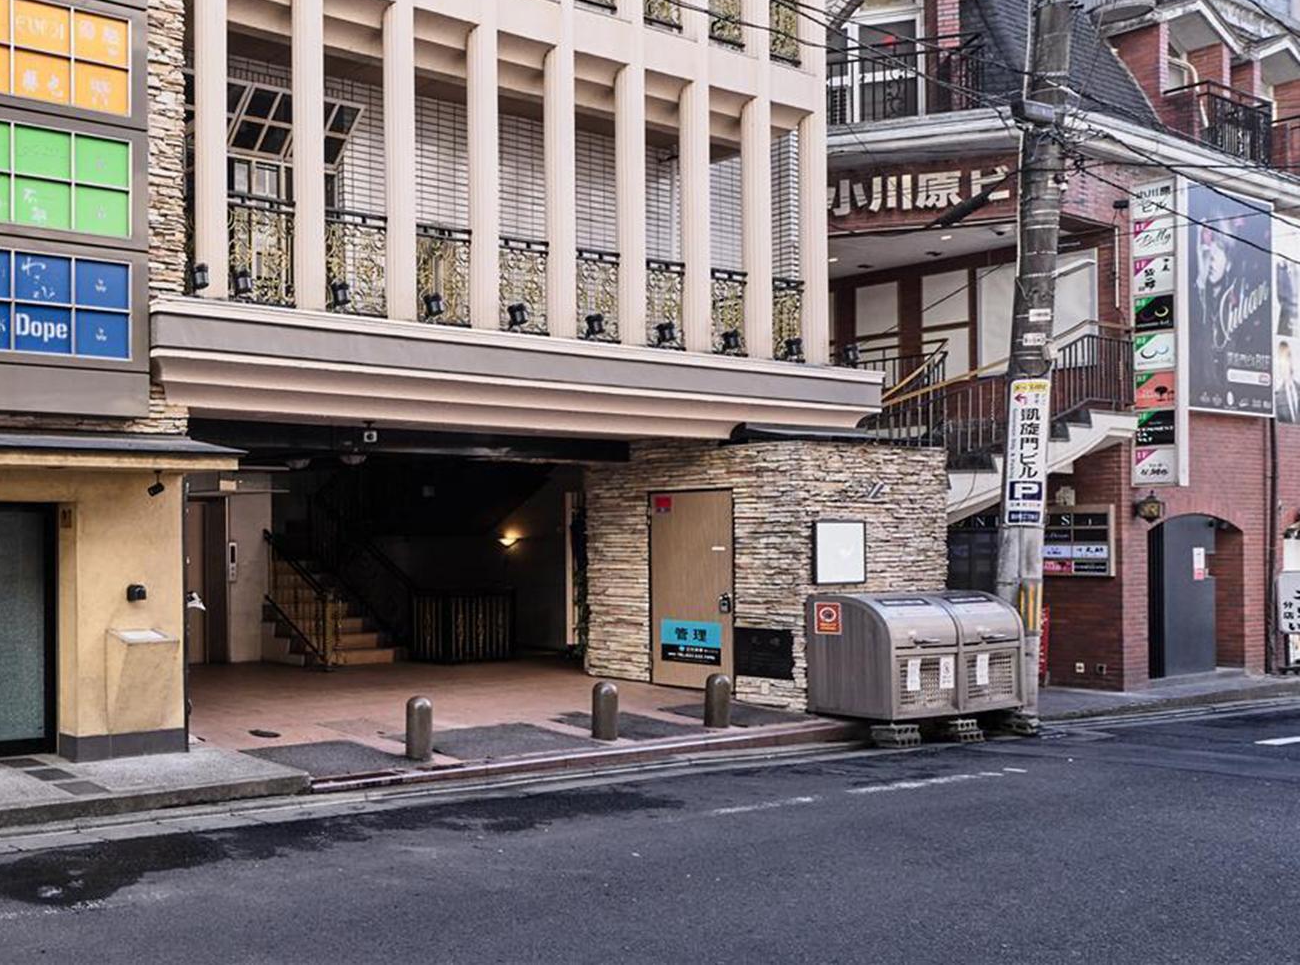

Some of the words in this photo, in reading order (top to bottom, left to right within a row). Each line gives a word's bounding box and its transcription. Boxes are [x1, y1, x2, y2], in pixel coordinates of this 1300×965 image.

[15, 312, 68, 342] Dope
[1019, 407, 1041, 479] 凱旋門ビル
[1013, 483, 1040, 499] P
[675, 626, 707, 642] 管理
